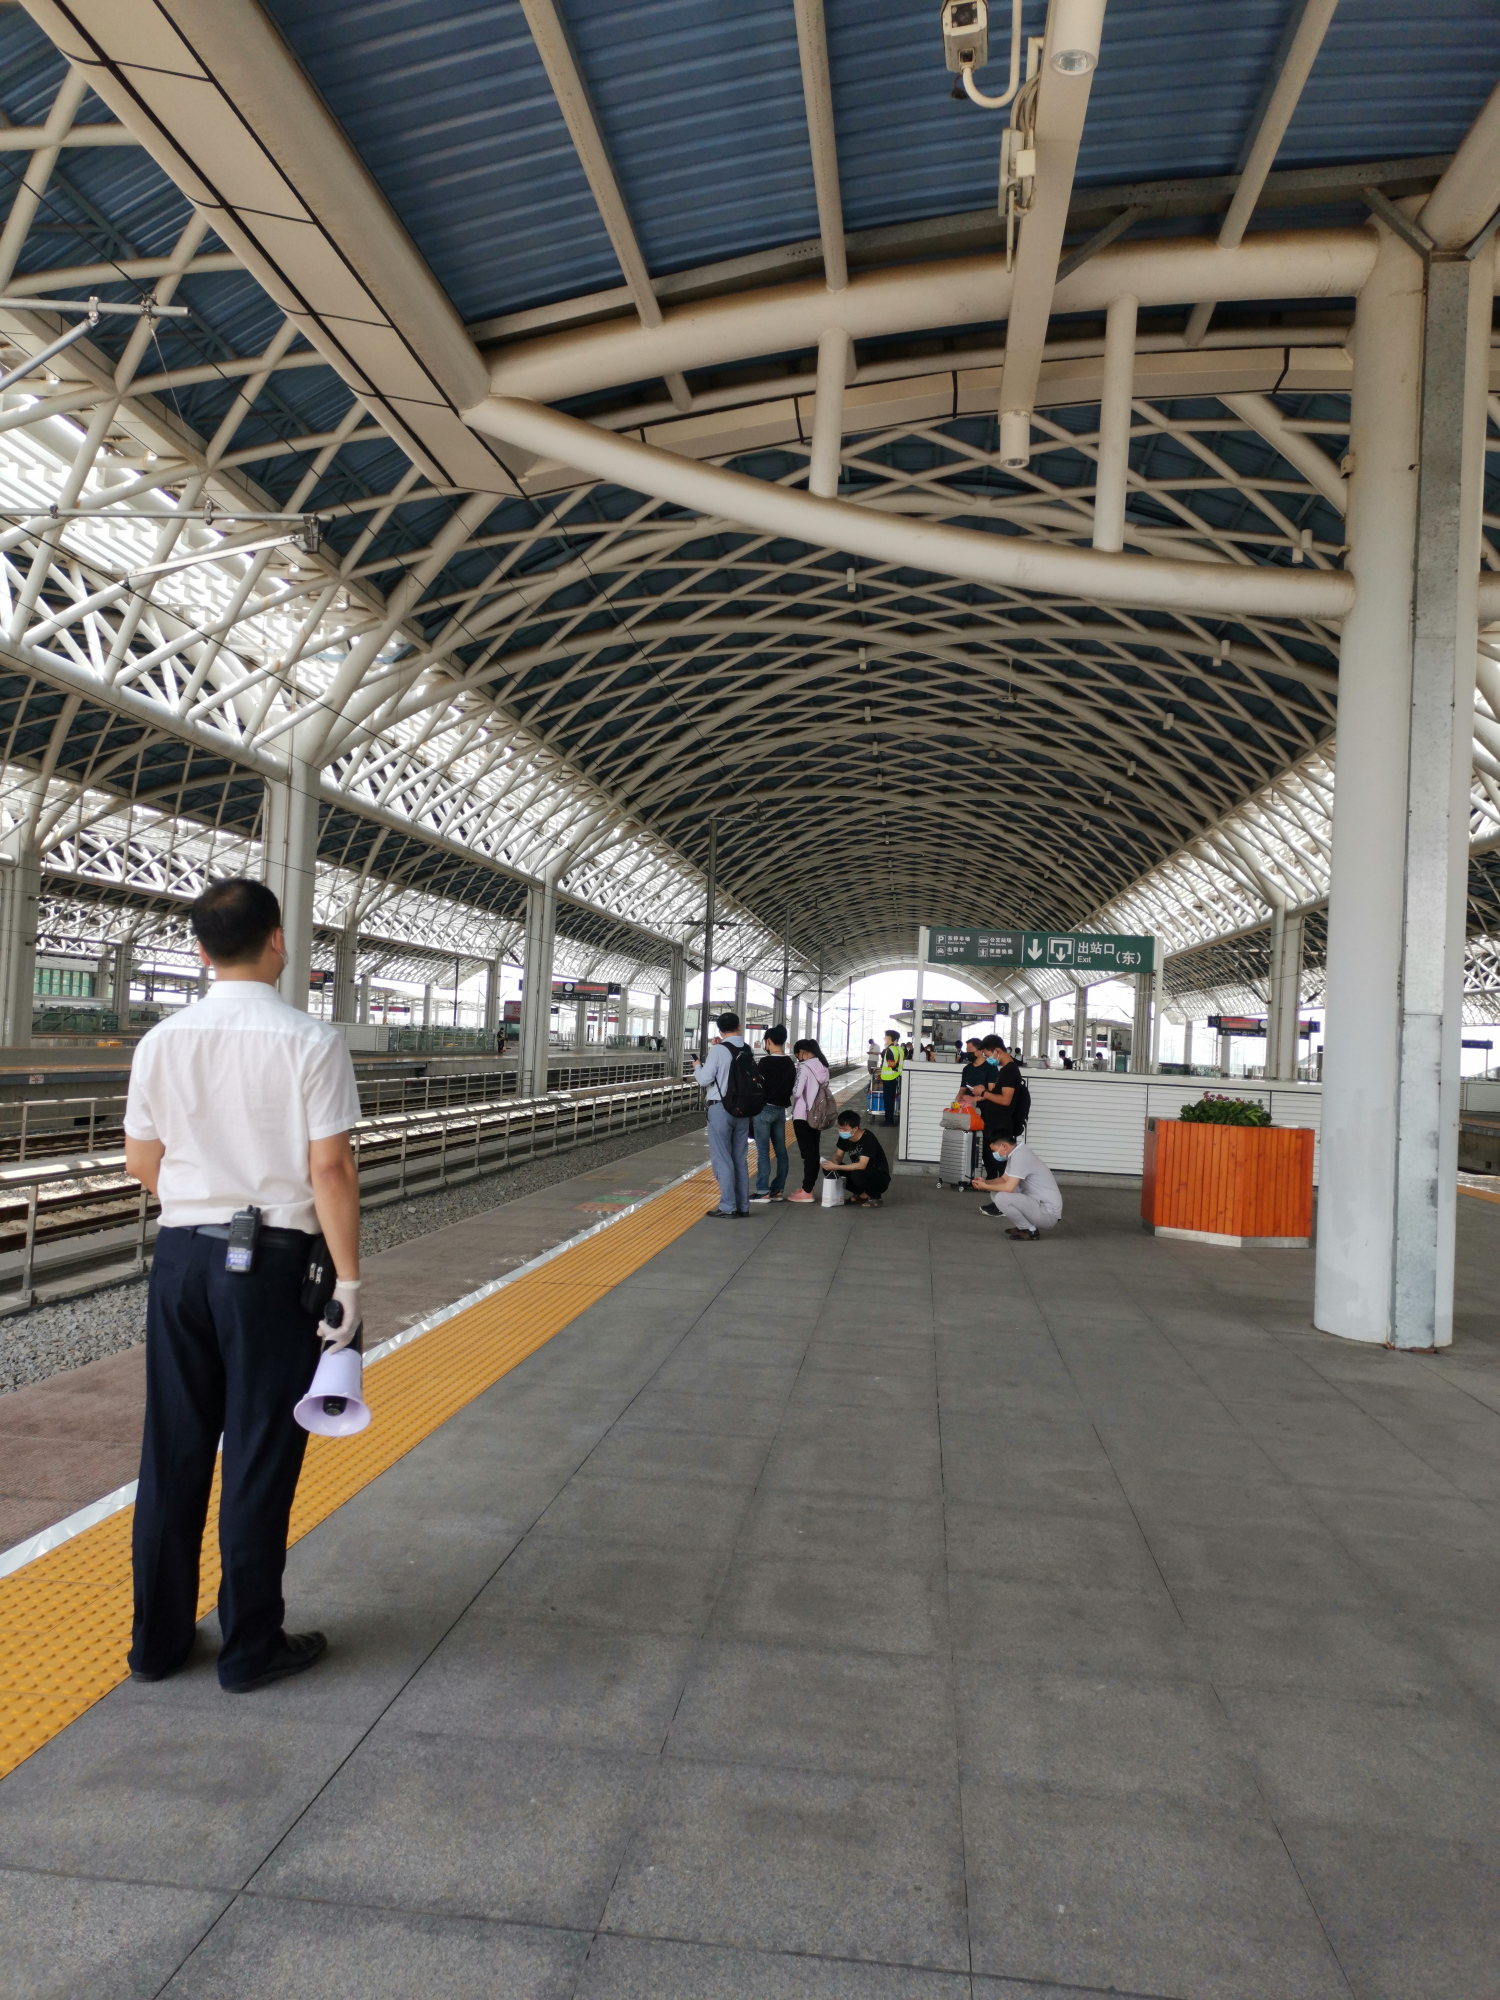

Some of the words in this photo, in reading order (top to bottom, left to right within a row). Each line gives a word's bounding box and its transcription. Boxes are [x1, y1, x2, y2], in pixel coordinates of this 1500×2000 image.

[1077, 941, 1115, 954] 出站口
[1077, 955, 1092, 963] Exit
[1210, 1018, 1220, 1026] 10
